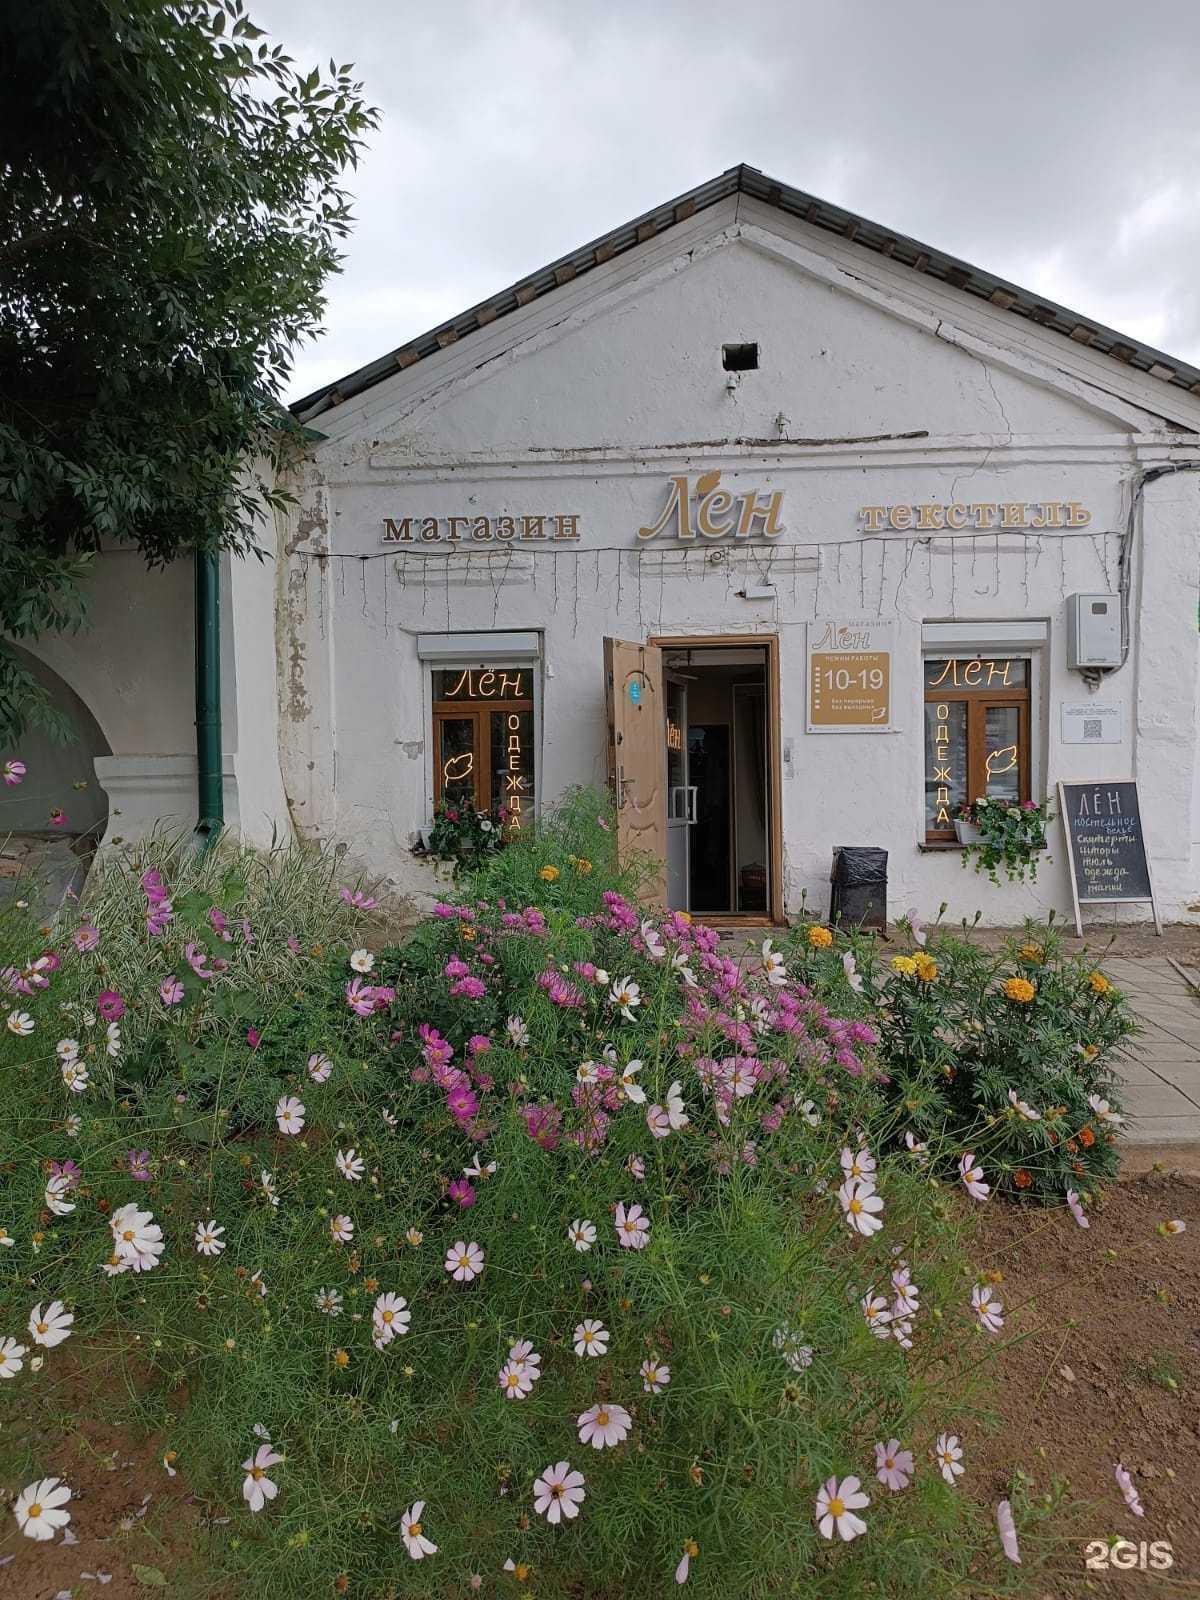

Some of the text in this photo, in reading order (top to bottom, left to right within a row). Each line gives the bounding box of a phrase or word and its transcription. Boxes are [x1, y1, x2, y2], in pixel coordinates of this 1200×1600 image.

[382, 513, 581, 543] магазин
[860, 502, 1094, 532] текстиль
[824, 669, 884, 690] 10-19
[505, 714, 525, 831] ОДЕЖДА
[933, 704, 952, 825] ОДЕЖДА
